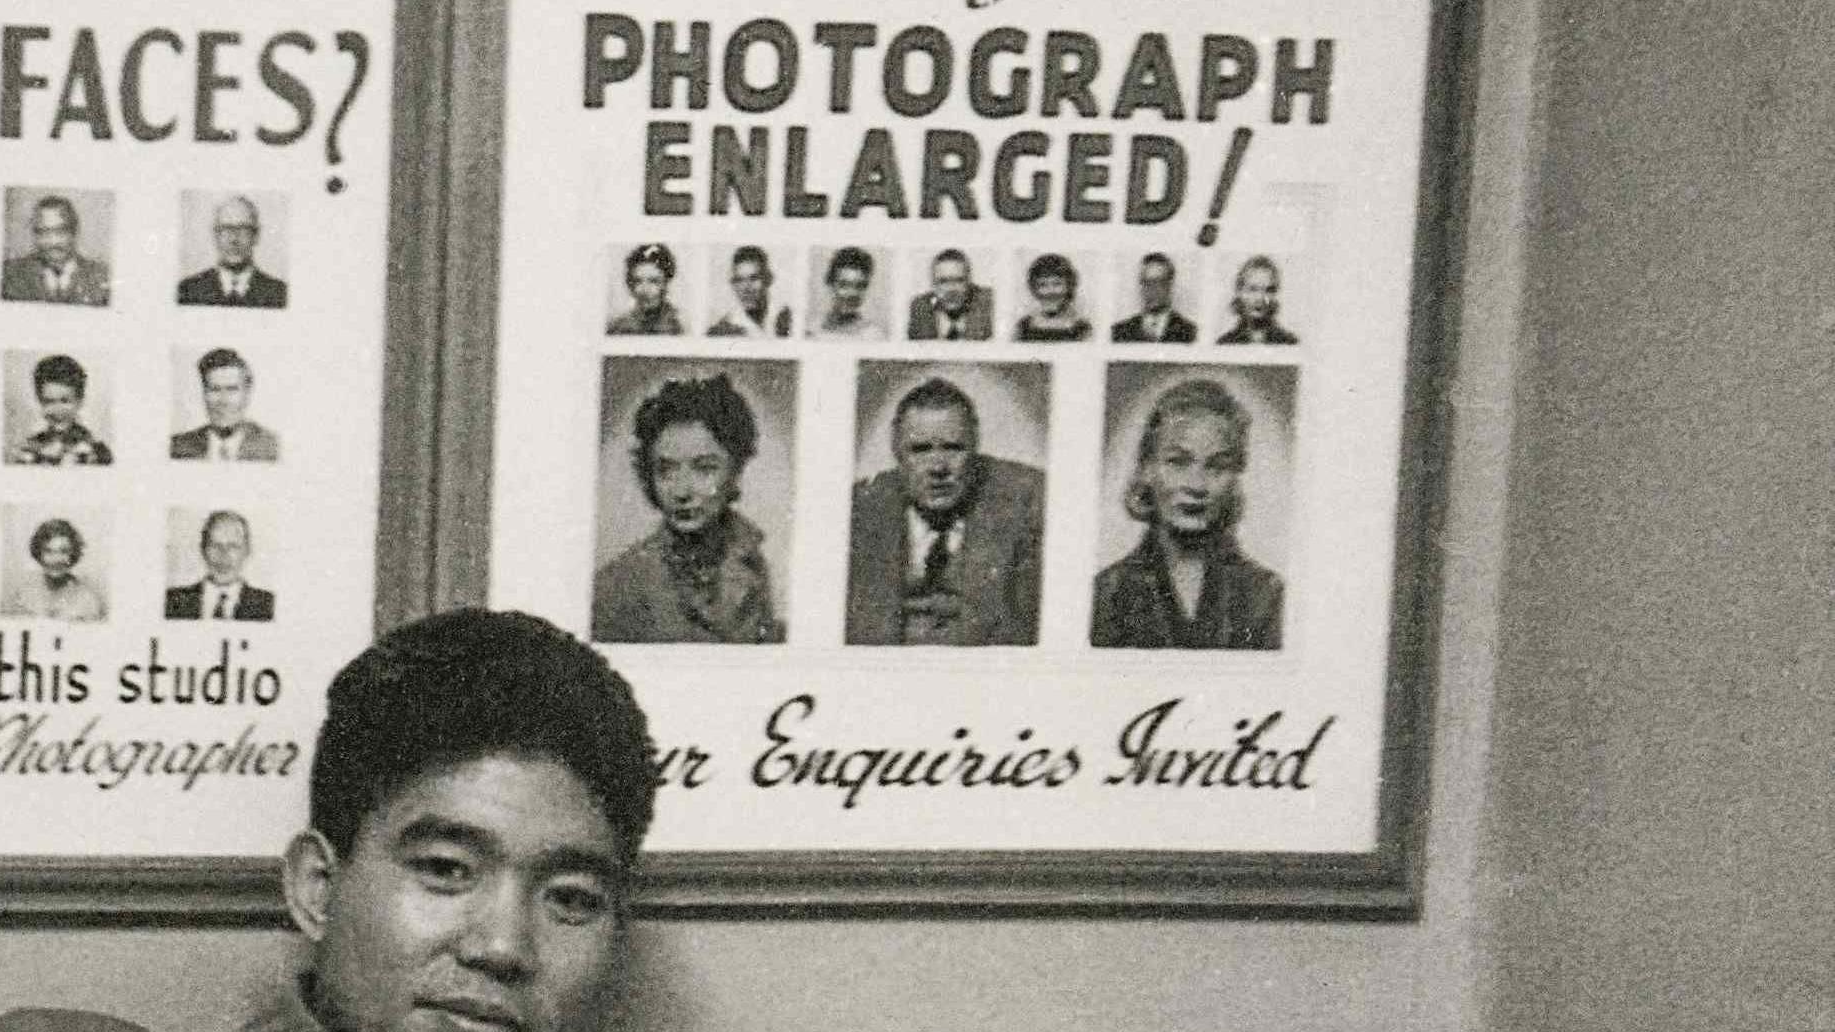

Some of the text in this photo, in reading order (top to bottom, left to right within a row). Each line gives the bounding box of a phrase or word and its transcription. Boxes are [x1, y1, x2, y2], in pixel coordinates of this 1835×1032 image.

[582, 12, 1336, 125] PHOTOGRAPH
[642, 120, 1255, 248] ENLARGED!
[118, 636, 283, 707] studio
[750, 692, 1083, 810] Enquiries
[1102, 696, 1339, 791] Invited
